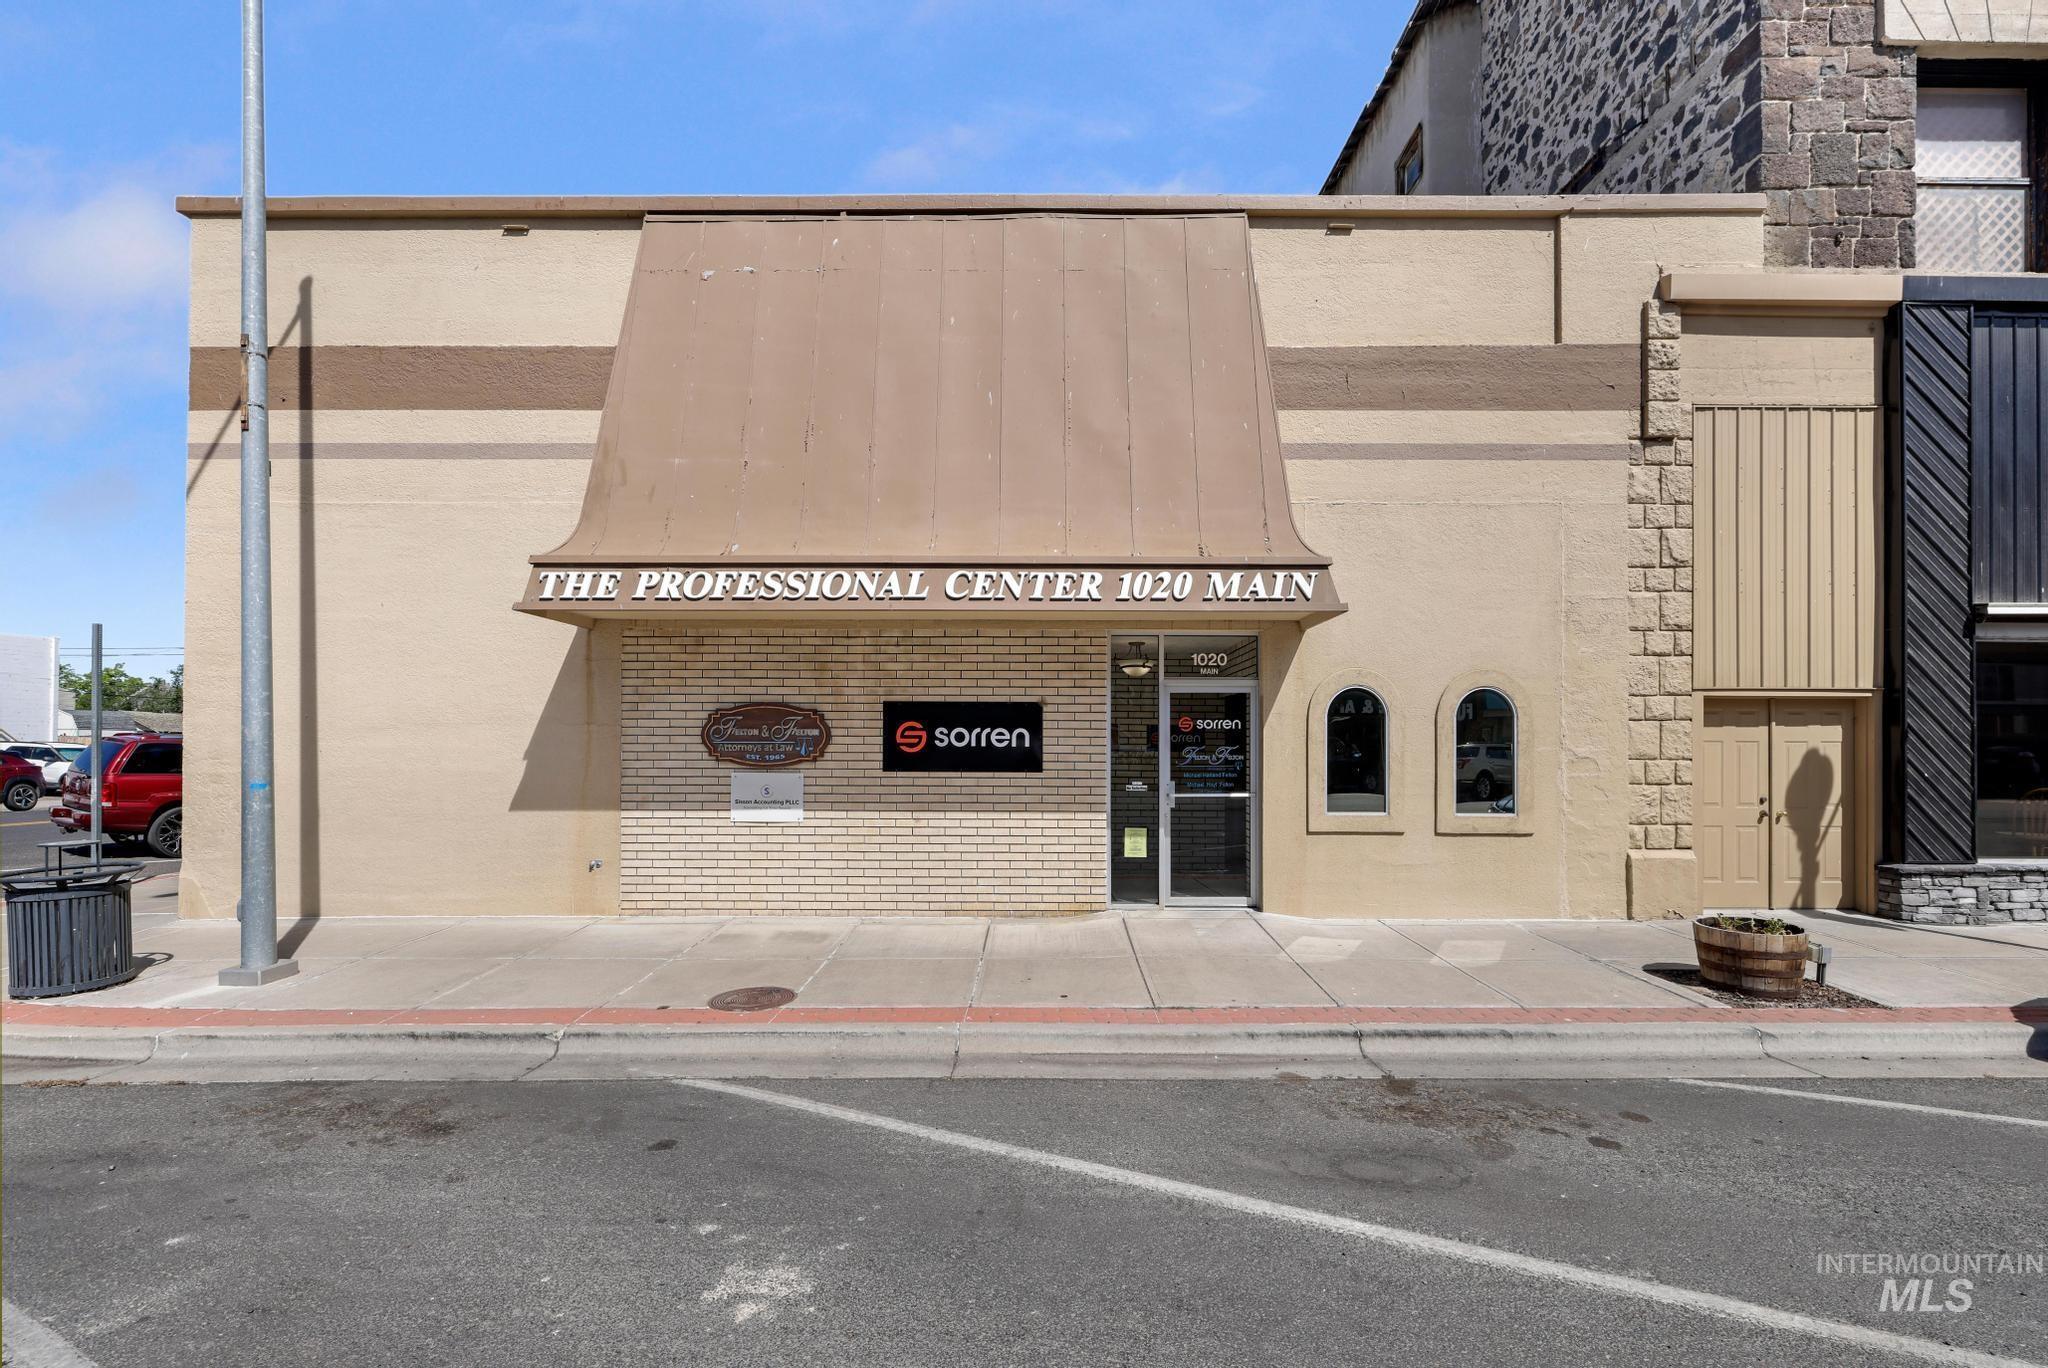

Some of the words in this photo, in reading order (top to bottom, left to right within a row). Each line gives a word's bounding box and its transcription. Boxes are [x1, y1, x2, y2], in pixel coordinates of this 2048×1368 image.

[538, 571, 622, 600] THE
[631, 570, 930, 600] PROFESSIONAL
[944, 570, 1103, 600] CENTER
[1116, 571, 1193, 600] 1020
[1202, 571, 1318, 601] MAIN
[1191, 653, 1228, 666] 1020
[1196, 719, 1241, 730] sorren
[761, 725, 770, 737] &
[934, 727, 1030, 748] sorren
[718, 744, 762, 754] Attorneys
[764, 744, 773, 752] at
[775, 744, 794, 752] Law
